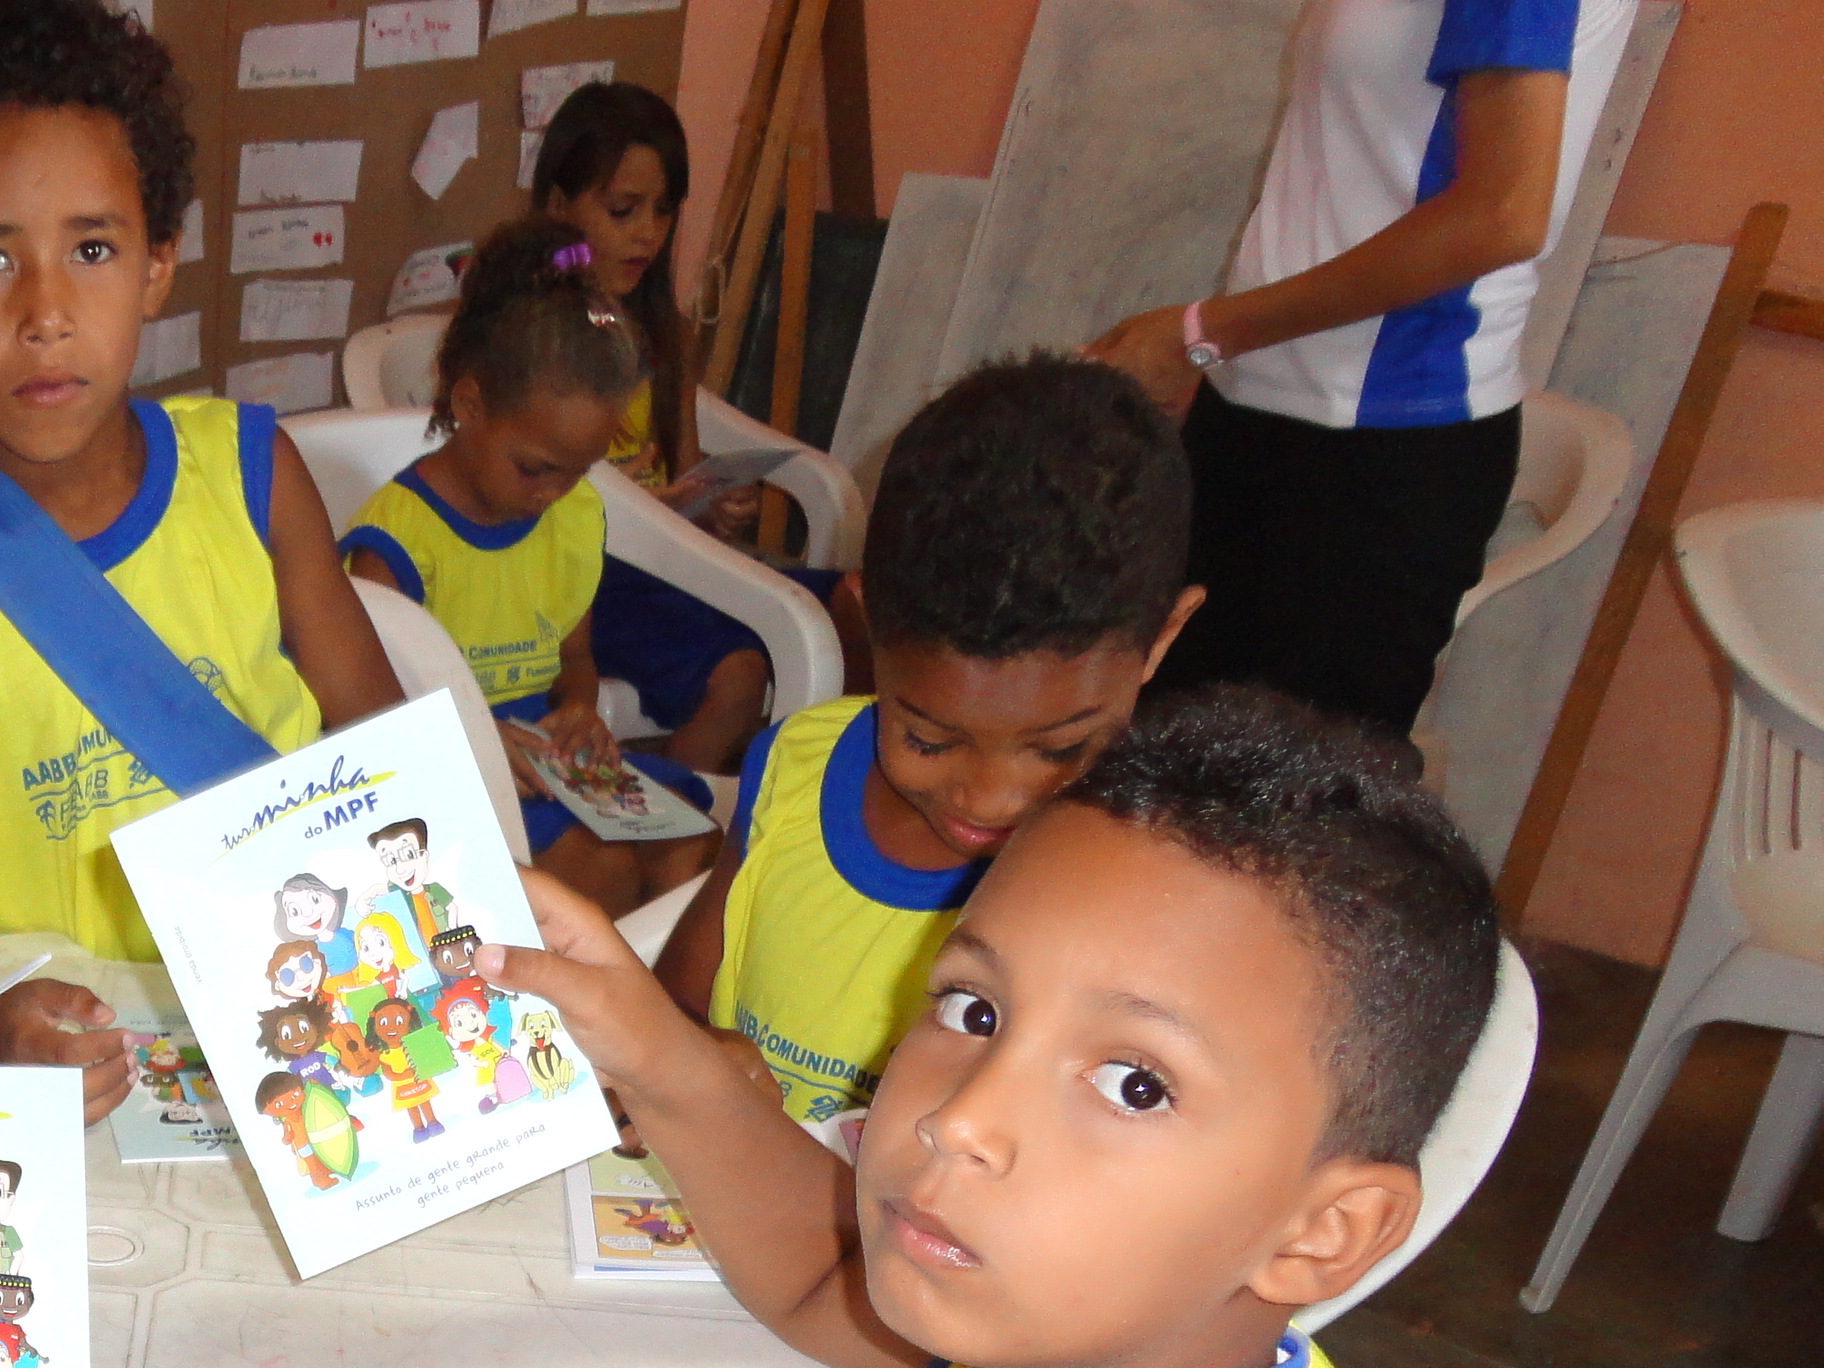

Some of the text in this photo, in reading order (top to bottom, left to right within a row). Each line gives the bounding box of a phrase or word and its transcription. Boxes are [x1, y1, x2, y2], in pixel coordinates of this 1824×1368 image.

[304, 791, 379, 839] do MPF
[299, 1061, 322, 1078] ROD
[355, 1186, 402, 1211] Assunto
[407, 1176, 422, 1189] de
[427, 1159, 460, 1182] gente
[417, 1161, 505, 1208] gente pequena
